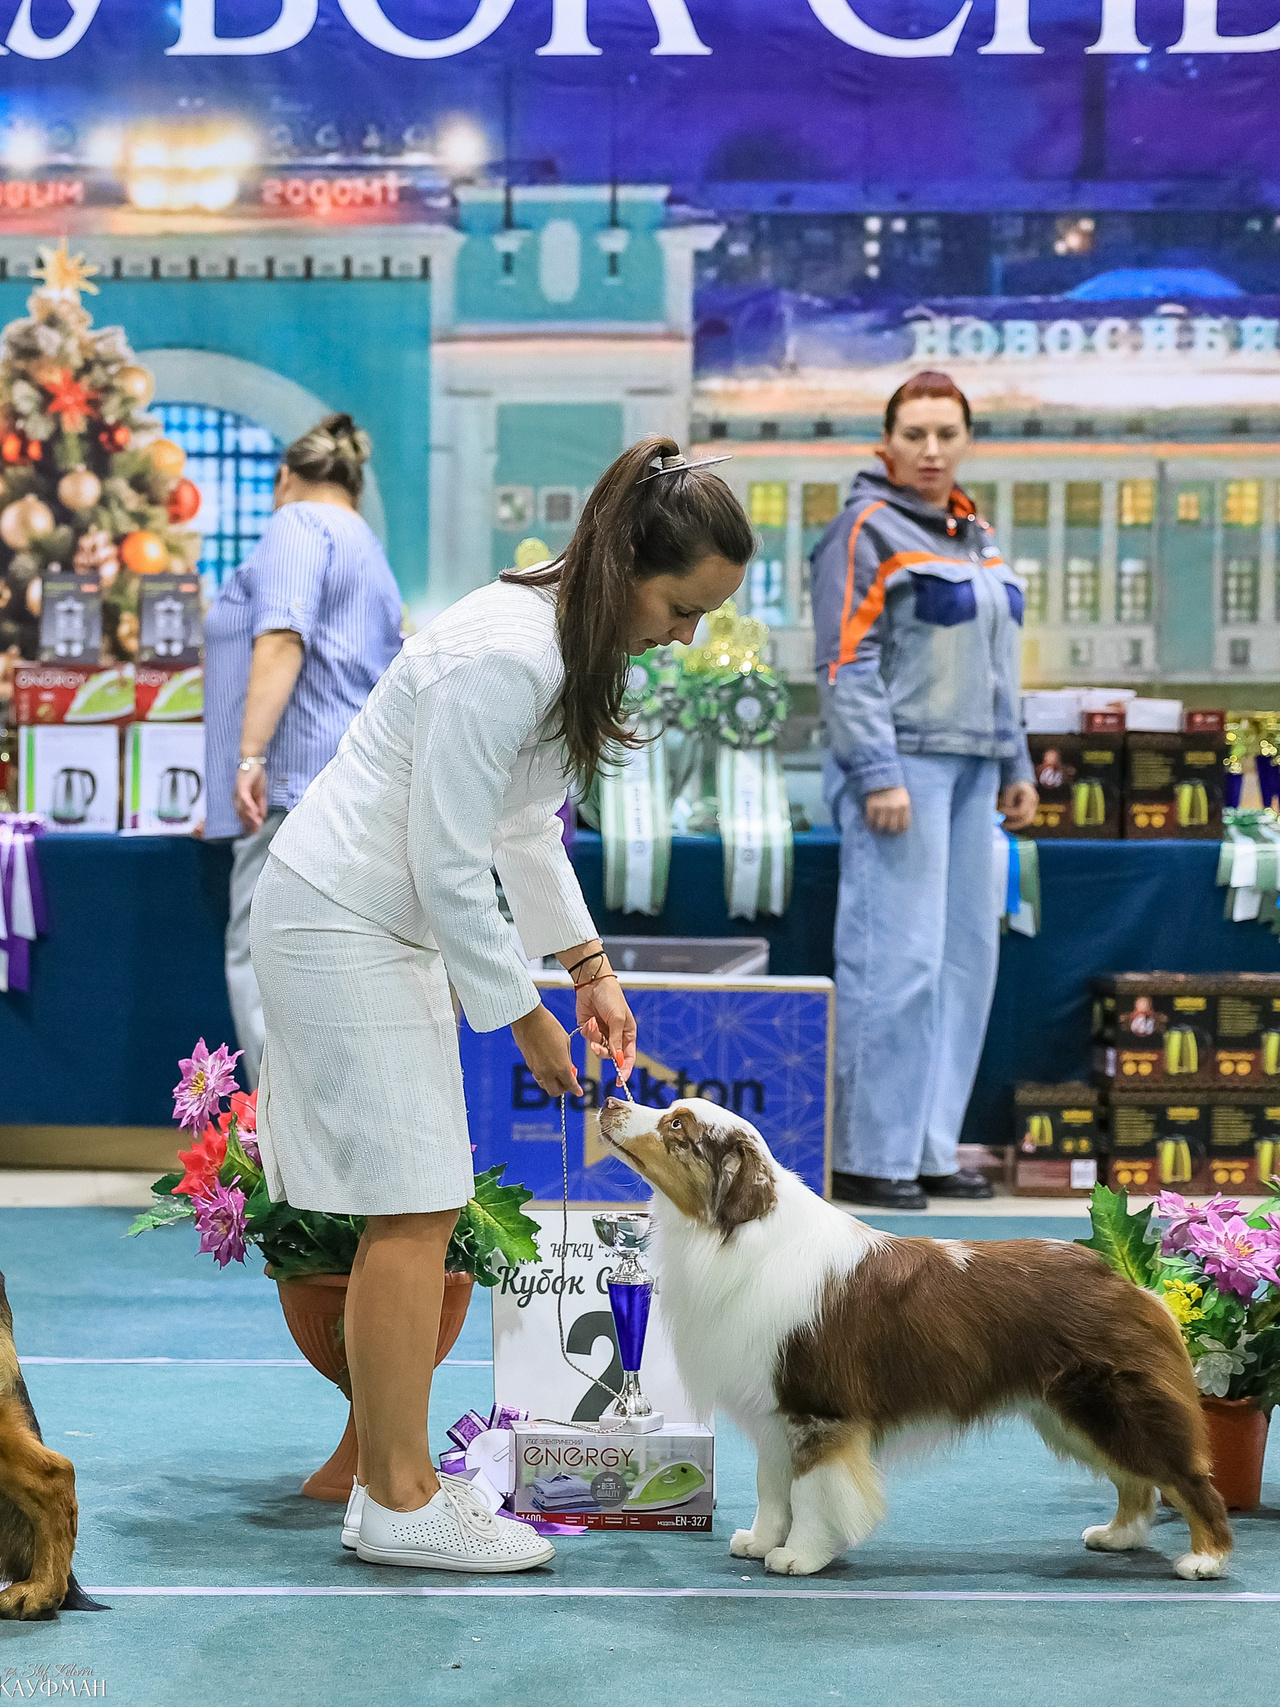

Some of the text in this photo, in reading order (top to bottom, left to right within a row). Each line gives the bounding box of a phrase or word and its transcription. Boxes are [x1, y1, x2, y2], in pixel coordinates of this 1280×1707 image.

[512, 1064, 764, 1111] Backton
[550, 1242, 594, 1261] НТКЦ
[497, 1264, 586, 1309] Кубок
[566, 1310, 624, 1422] 2
[596, 1490, 620, 1498] QUALITY
[601, 1482, 616, 1490] BEST
[675, 1515, 708, 1527] EN-327
